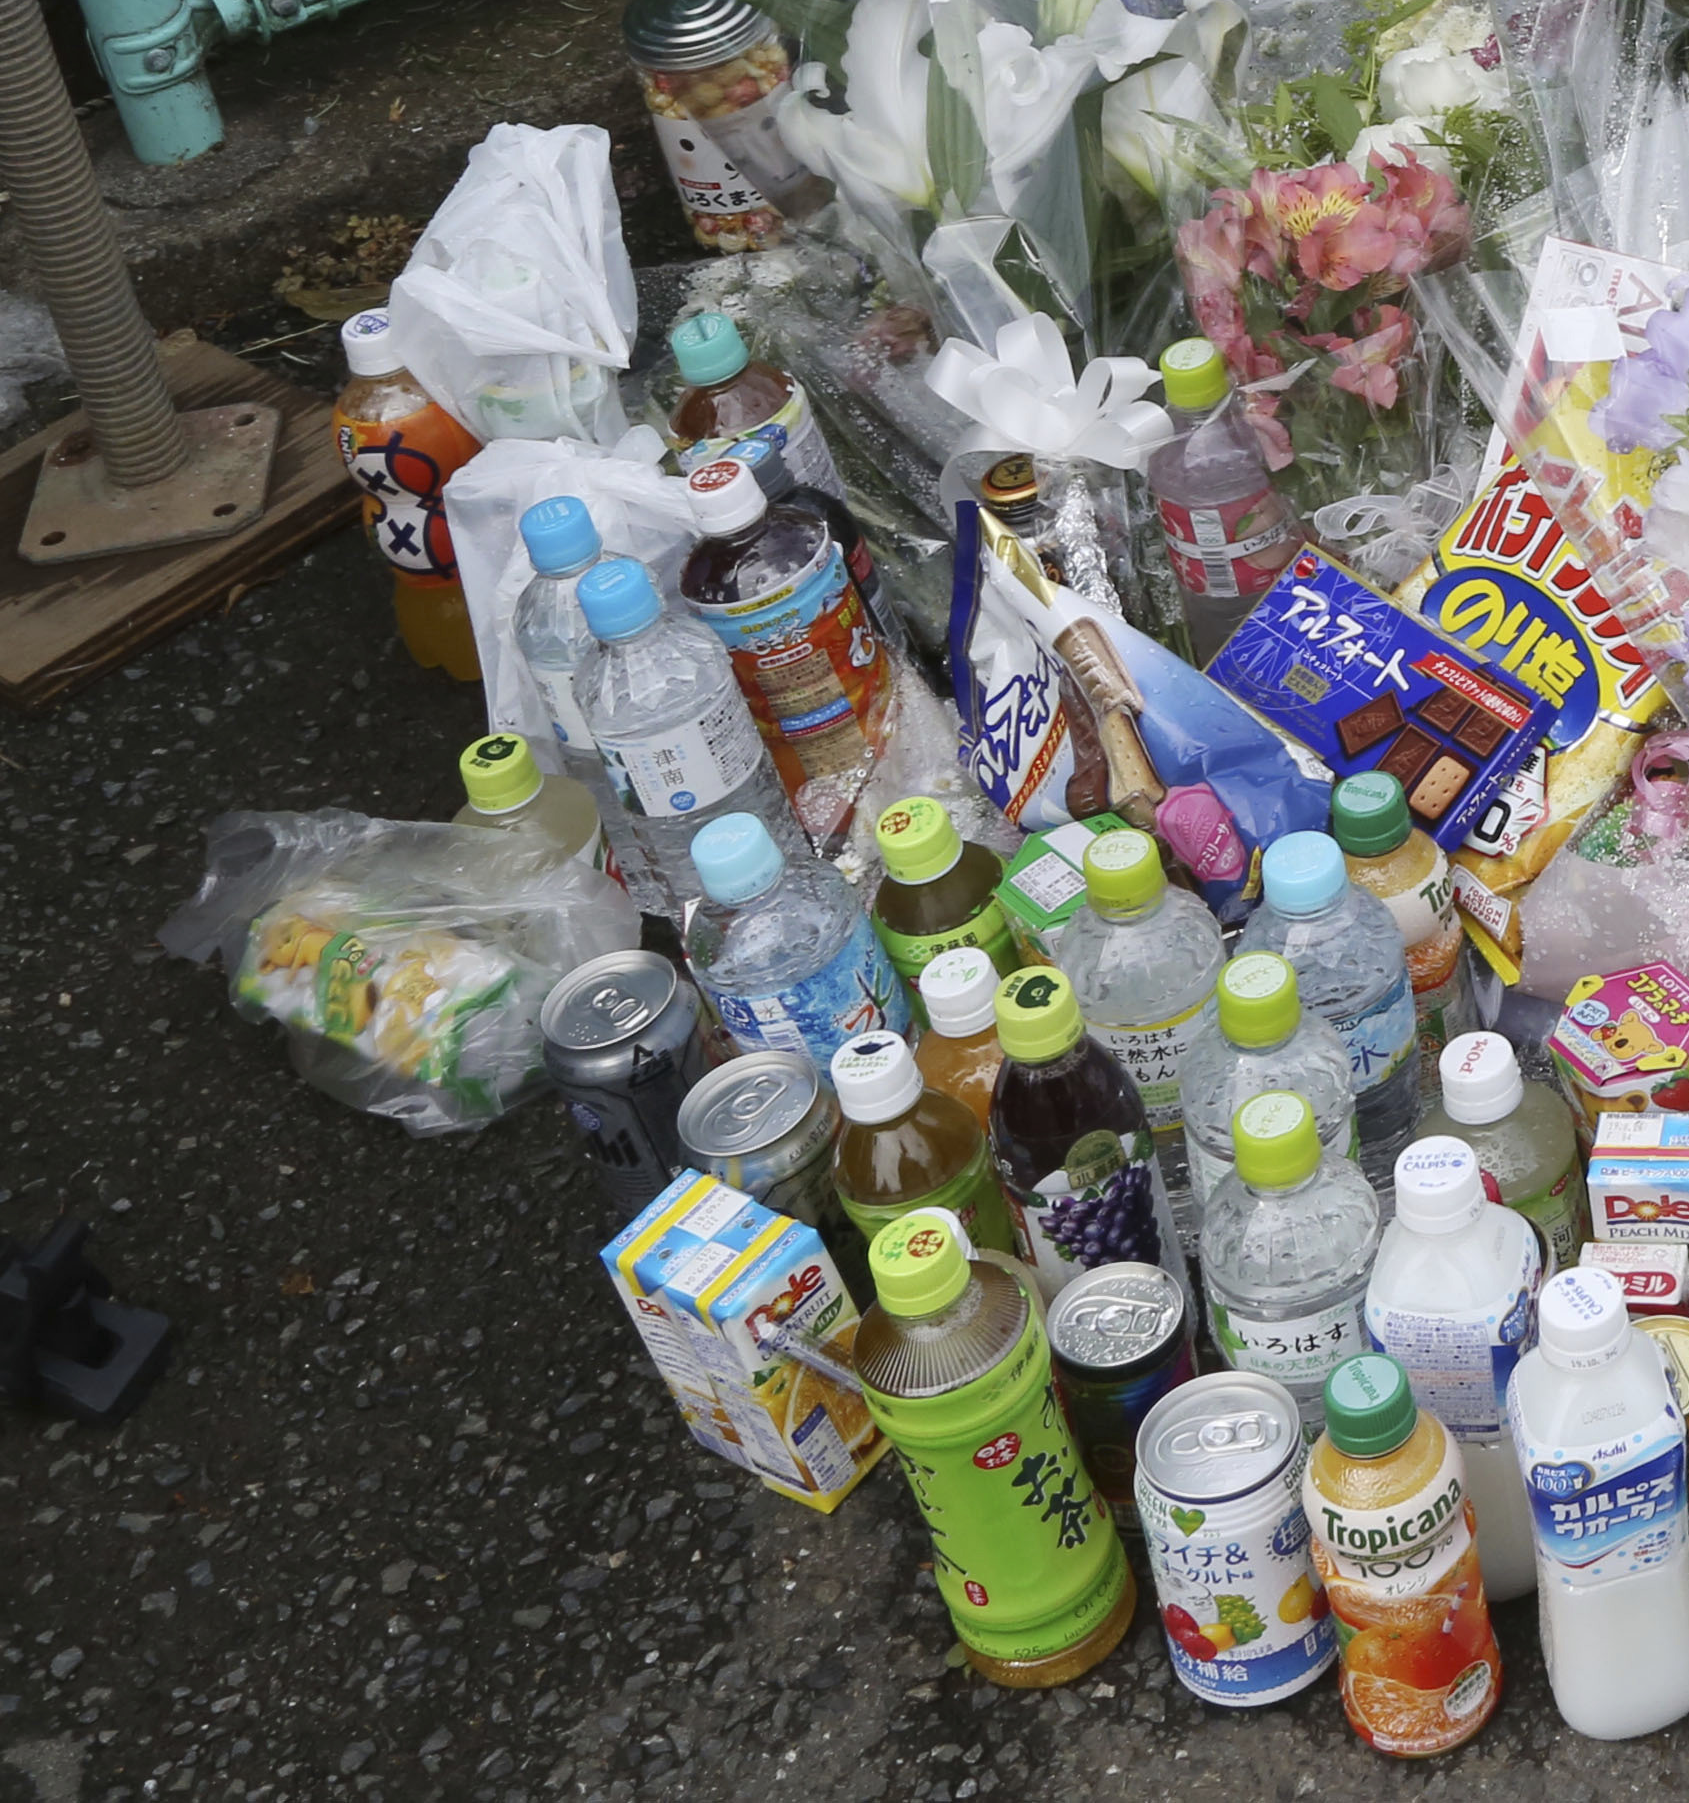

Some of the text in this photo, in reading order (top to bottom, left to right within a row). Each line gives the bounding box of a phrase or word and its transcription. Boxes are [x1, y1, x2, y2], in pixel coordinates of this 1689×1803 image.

[1278, 584, 1411, 691] アルフォート
[1438, 578, 1587, 710] のり塩
[652, 748, 684, 790] 津南
[1194, 820, 1231, 880] ファミリーサ
[1467, 883, 1493, 909] FOOD
[1467, 894, 1504, 922] ACTION
[1463, 900, 1503, 930] NIPPON
[929, 932, 978, 959] 伊藤園
[1109, 1026, 1177, 1047] いろはす
[1459, 1038, 1489, 1075] POM
[1134, 1064, 1178, 1085] もん
[1402, 1158, 1448, 1173] CALPIS
[1608, 1225, 1661, 1241] PEACH
[745, 1263, 823, 1344] Dole
[1238, 1322, 1349, 1354] いろはす
[1247, 1350, 1343, 1374] 日本の天然水
[1346, 1358, 1381, 1405] Tropicana
[1590, 1440, 1628, 1462] Asahi
[1010, 1450, 1095, 1551] お茶
[1321, 1475, 1463, 1554] Tropicana
[1549, 1477, 1677, 1525] カルピス
[1553, 1497, 1675, 1544] ウォーター
[1349, 1535, 1454, 1581] 100%
[1384, 1574, 1430, 1597] オレンジ
